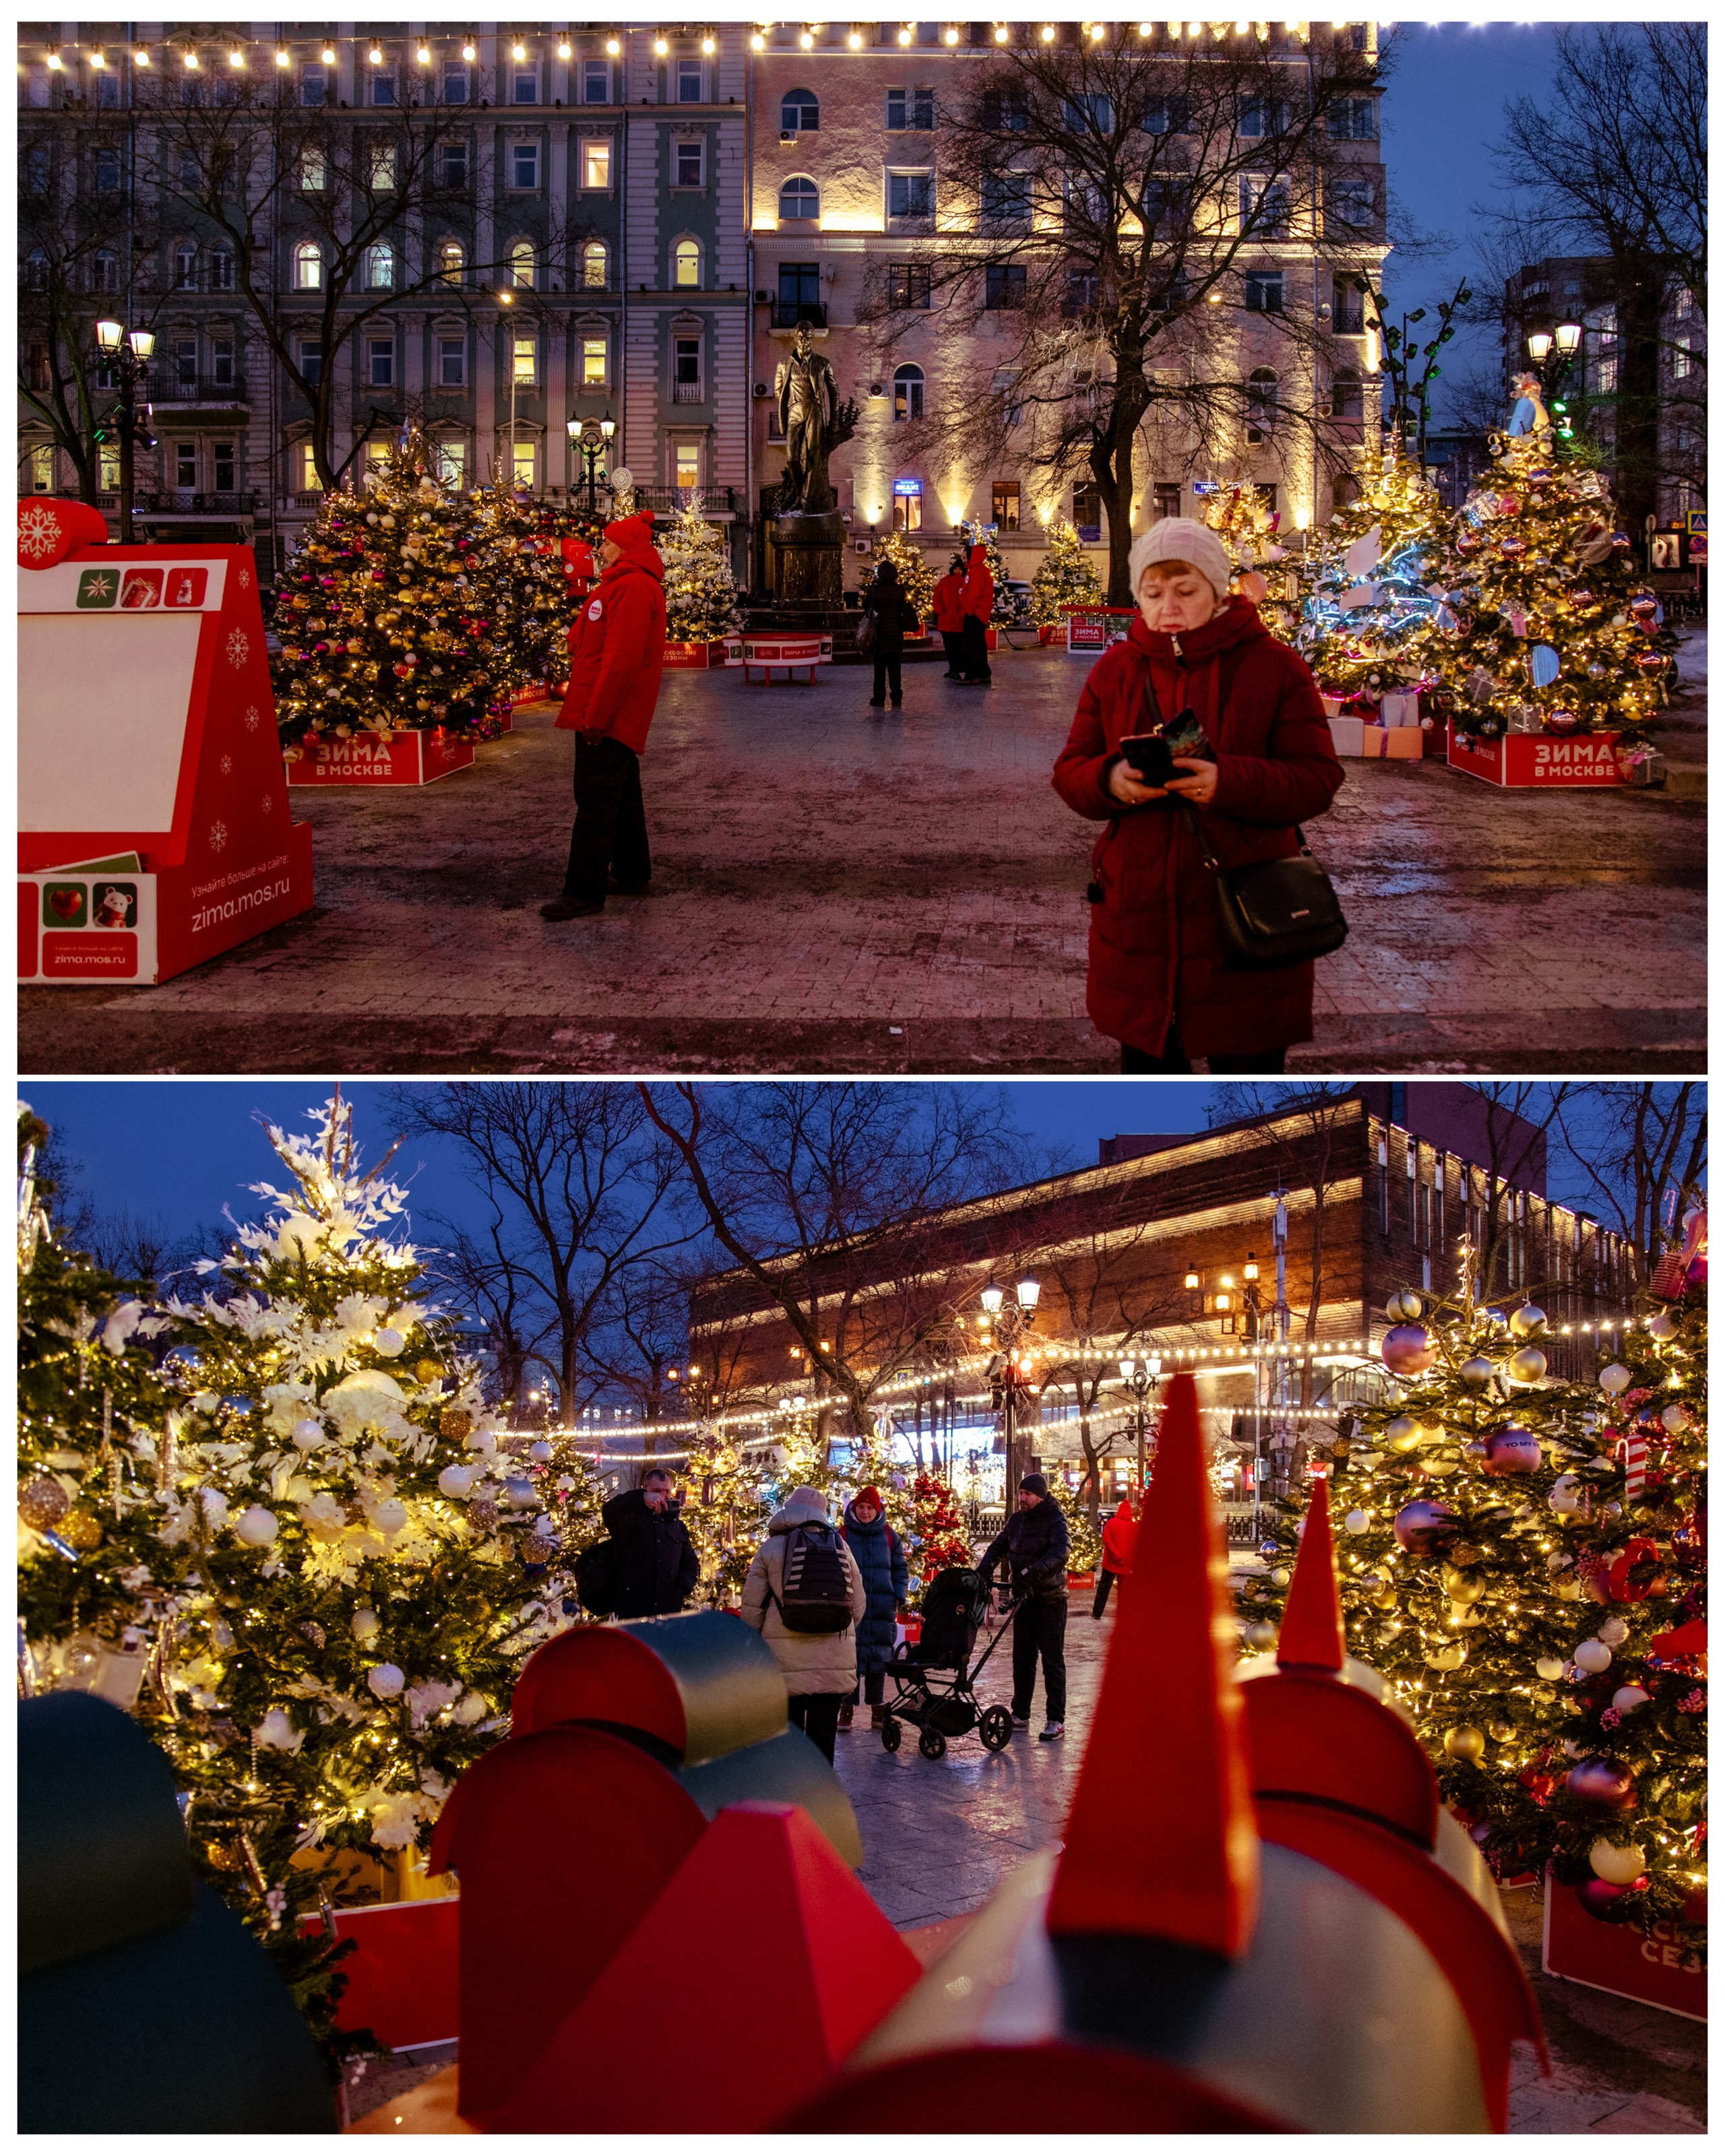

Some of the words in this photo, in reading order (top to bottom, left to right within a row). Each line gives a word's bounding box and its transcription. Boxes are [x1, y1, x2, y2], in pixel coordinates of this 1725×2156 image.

[1050, 629, 1067, 637] ЗИ
[524, 688, 546, 699] МОСКВЕ
[316, 743, 391, 762] ЗИМА
[1534, 744, 1614, 763] ЗИМА
[316, 765, 325, 775] В
[330, 764, 392, 775] МОСКВЕ
[1534, 766, 1545, 777] В
[1549, 765, 1614, 776] МОСКВЕ
[191, 879, 226, 898] Узнайте
[227, 866, 256, 885] больше
[257, 863, 266, 873] на
[268, 854, 289, 870] сайте:
[191, 877, 290, 932] zima.mos.ru
[55, 954, 125, 964] zima.mos.ru
[1641, 1940, 1707, 1974] СЕЗ
